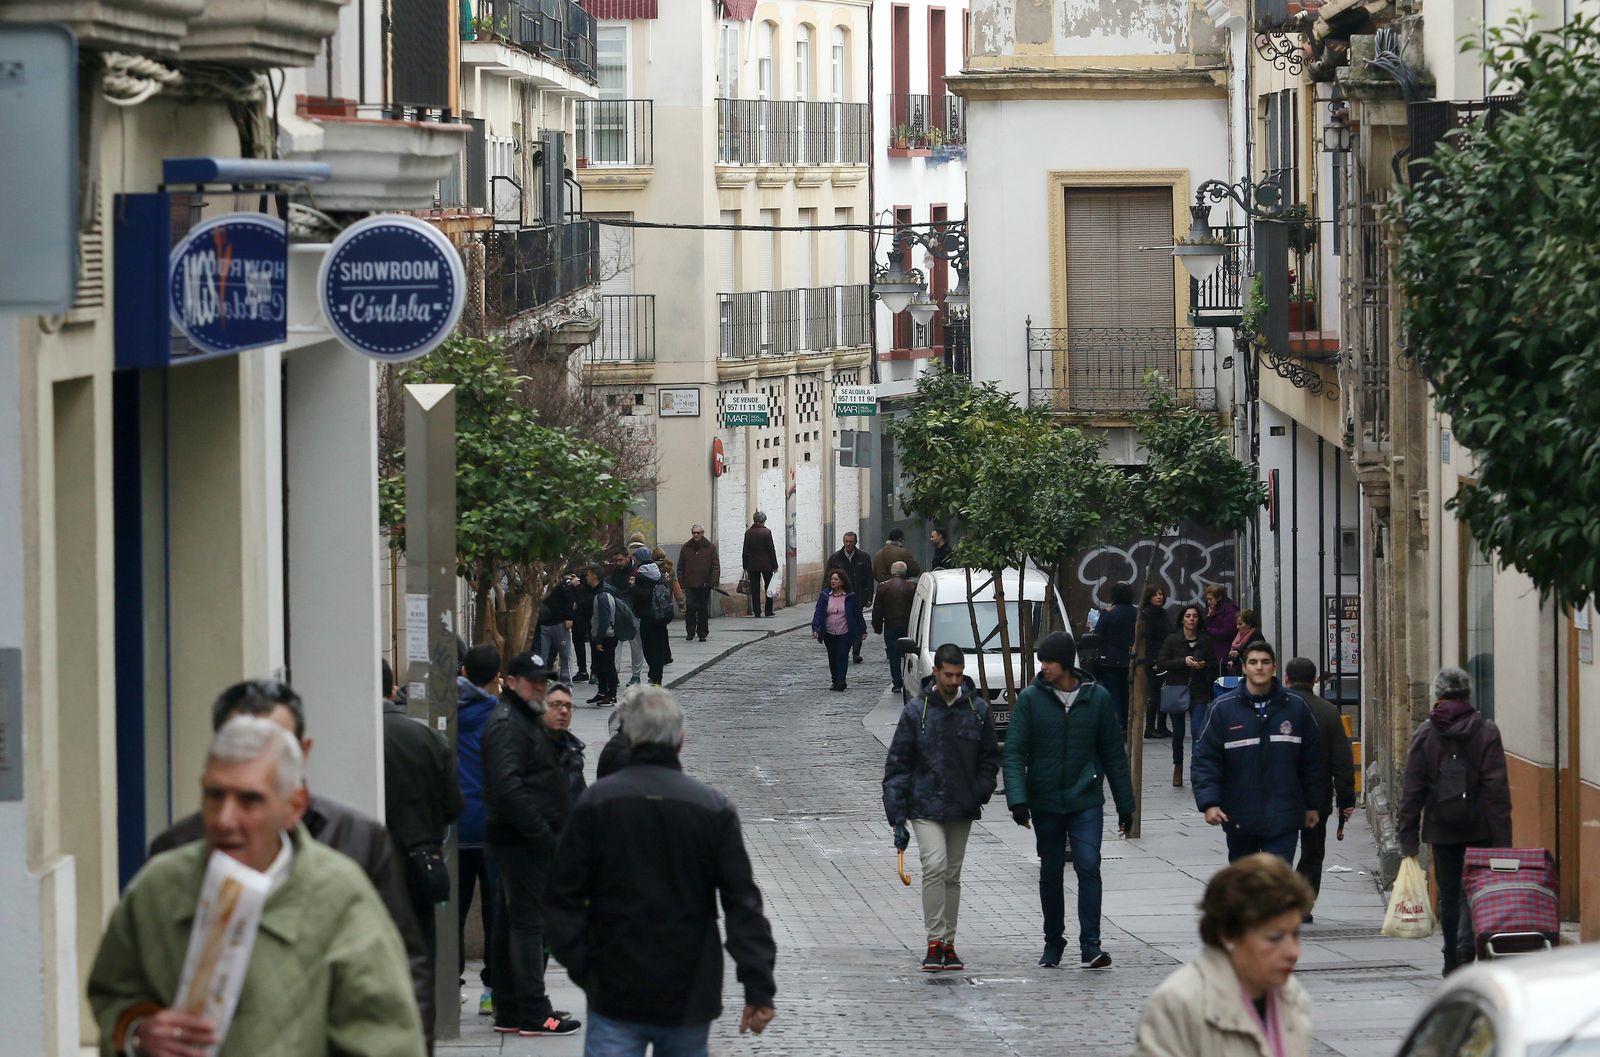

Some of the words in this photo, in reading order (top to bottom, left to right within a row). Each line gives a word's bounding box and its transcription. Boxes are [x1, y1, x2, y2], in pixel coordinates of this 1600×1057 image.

[339, 260, 440, 282] SHOWROOM
[350, 293, 431, 323] Córdoba
[732, 396, 740, 404] SE
[741, 396, 759, 404] VENDE
[727, 403, 738, 411] 957
[727, 414, 748, 422] MAR
